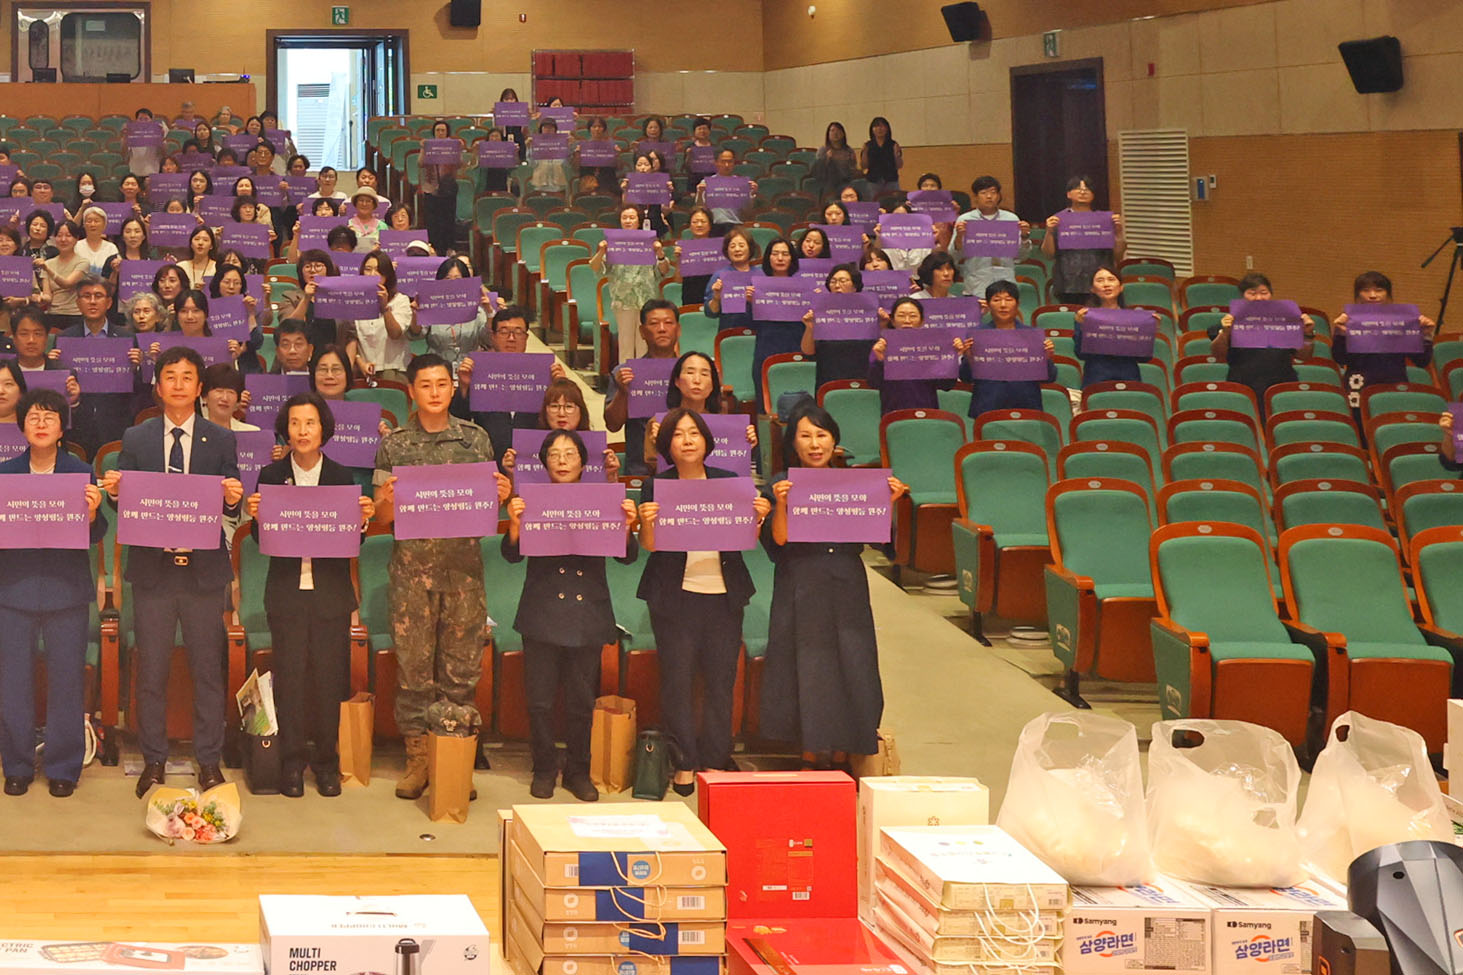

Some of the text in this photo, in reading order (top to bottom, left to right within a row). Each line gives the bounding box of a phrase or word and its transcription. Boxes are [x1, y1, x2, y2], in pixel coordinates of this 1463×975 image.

[1084, 918, 1117, 926] Samyang
[1238, 921, 1272, 930] Samyang
[1080, 932, 1134, 955] 삼양라면
[1235, 937, 1291, 960] 삼양라면
[289, 947, 321, 959] MULTI
[289, 960, 337, 971] CHOPPER
